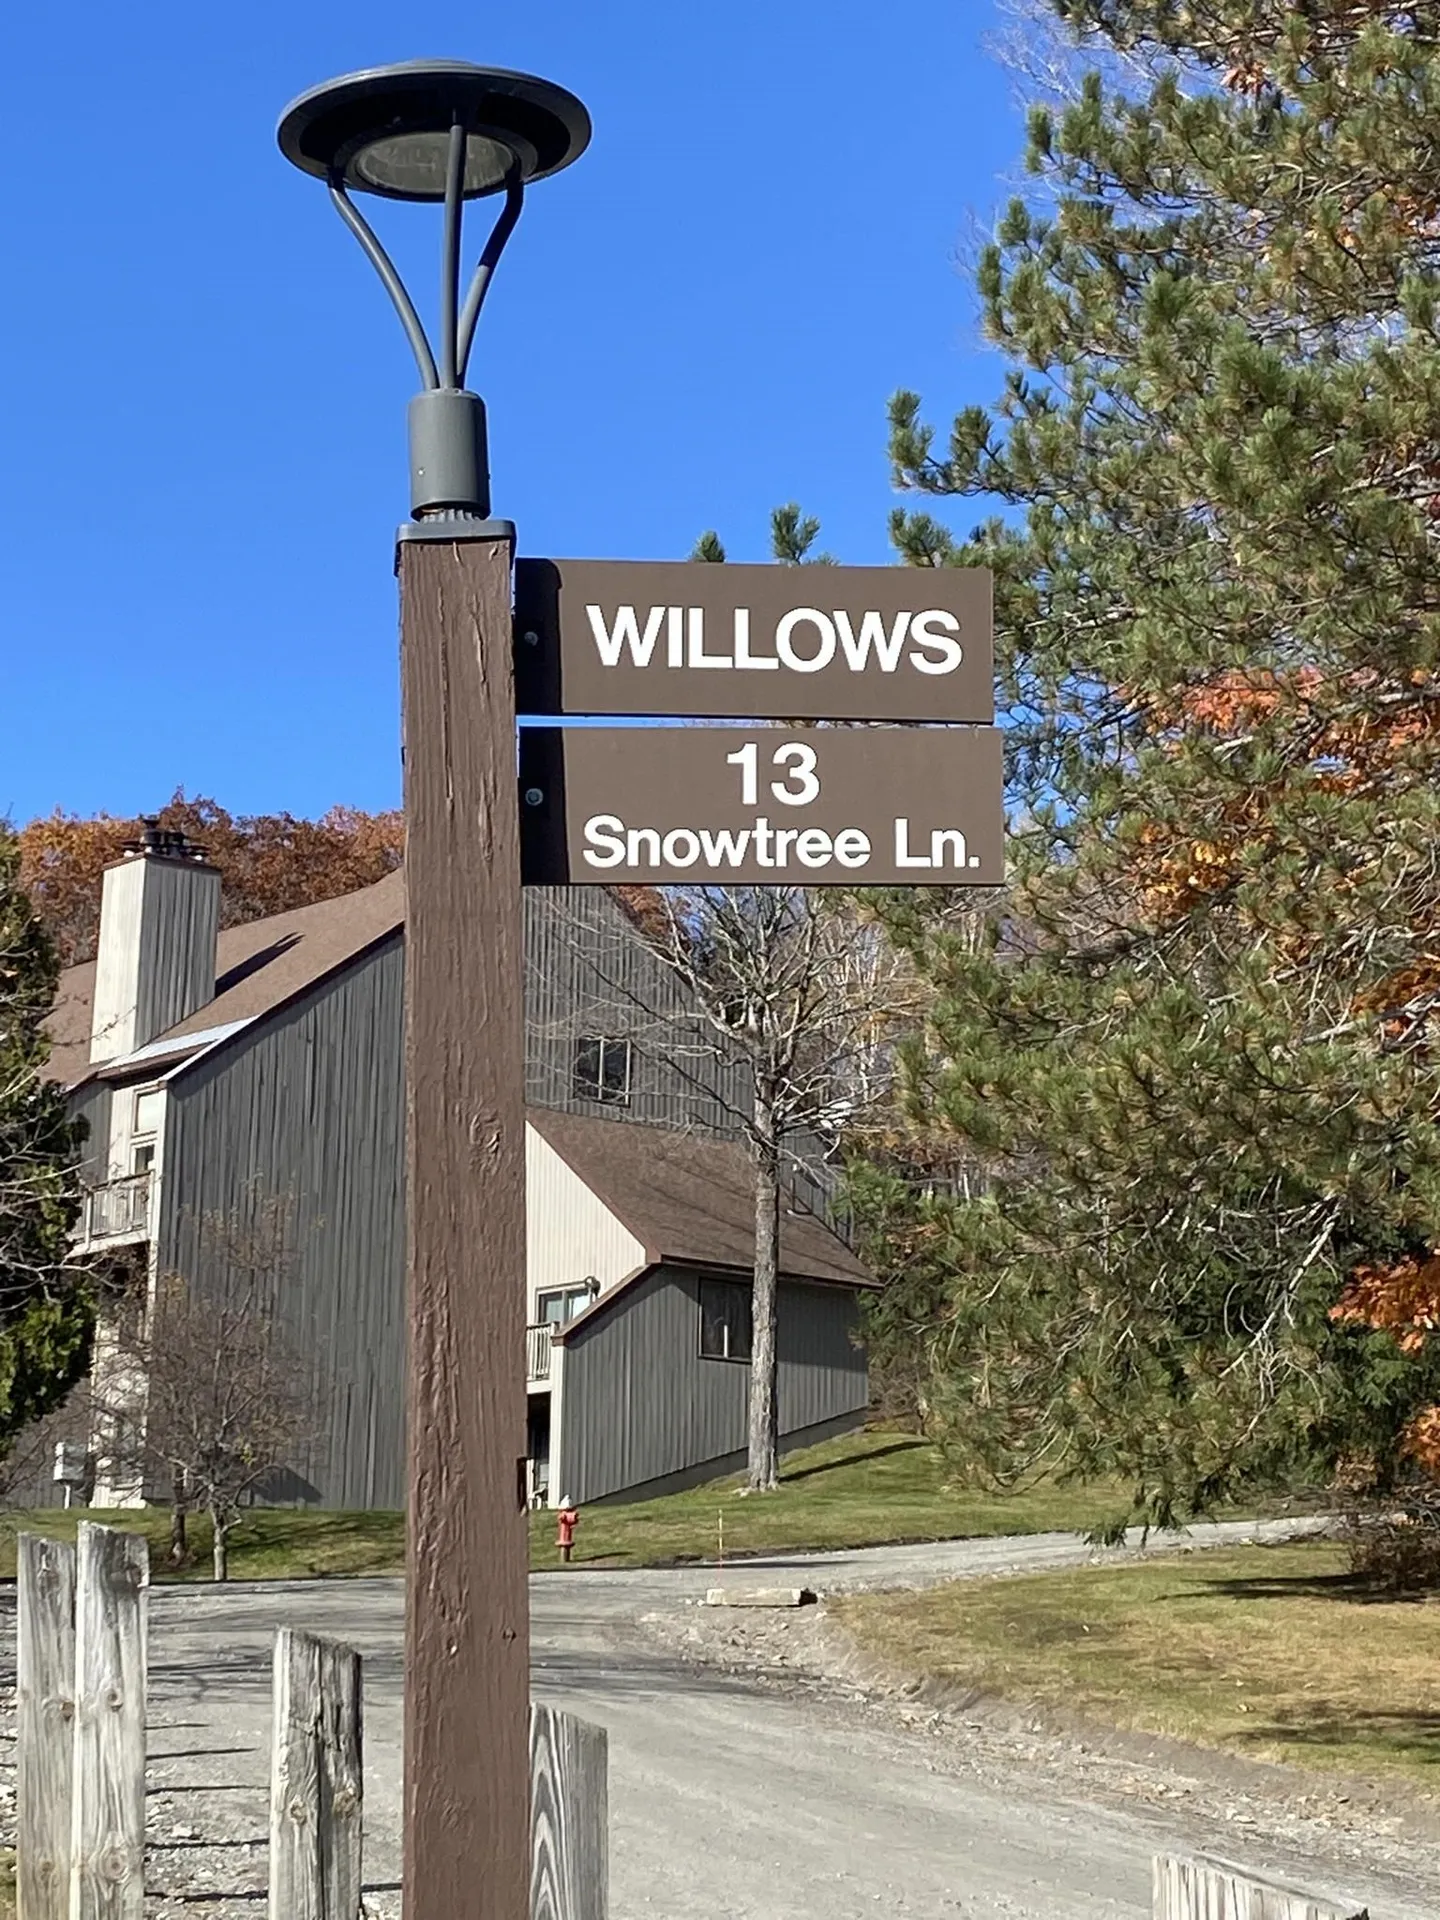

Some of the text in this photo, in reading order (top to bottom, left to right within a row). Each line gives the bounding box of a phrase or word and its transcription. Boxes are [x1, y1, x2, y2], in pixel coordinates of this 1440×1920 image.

[585, 604, 963, 675] WILLOWS
[726, 742, 820, 806] 13
[582, 814, 981, 869] Snowtree Ln.
